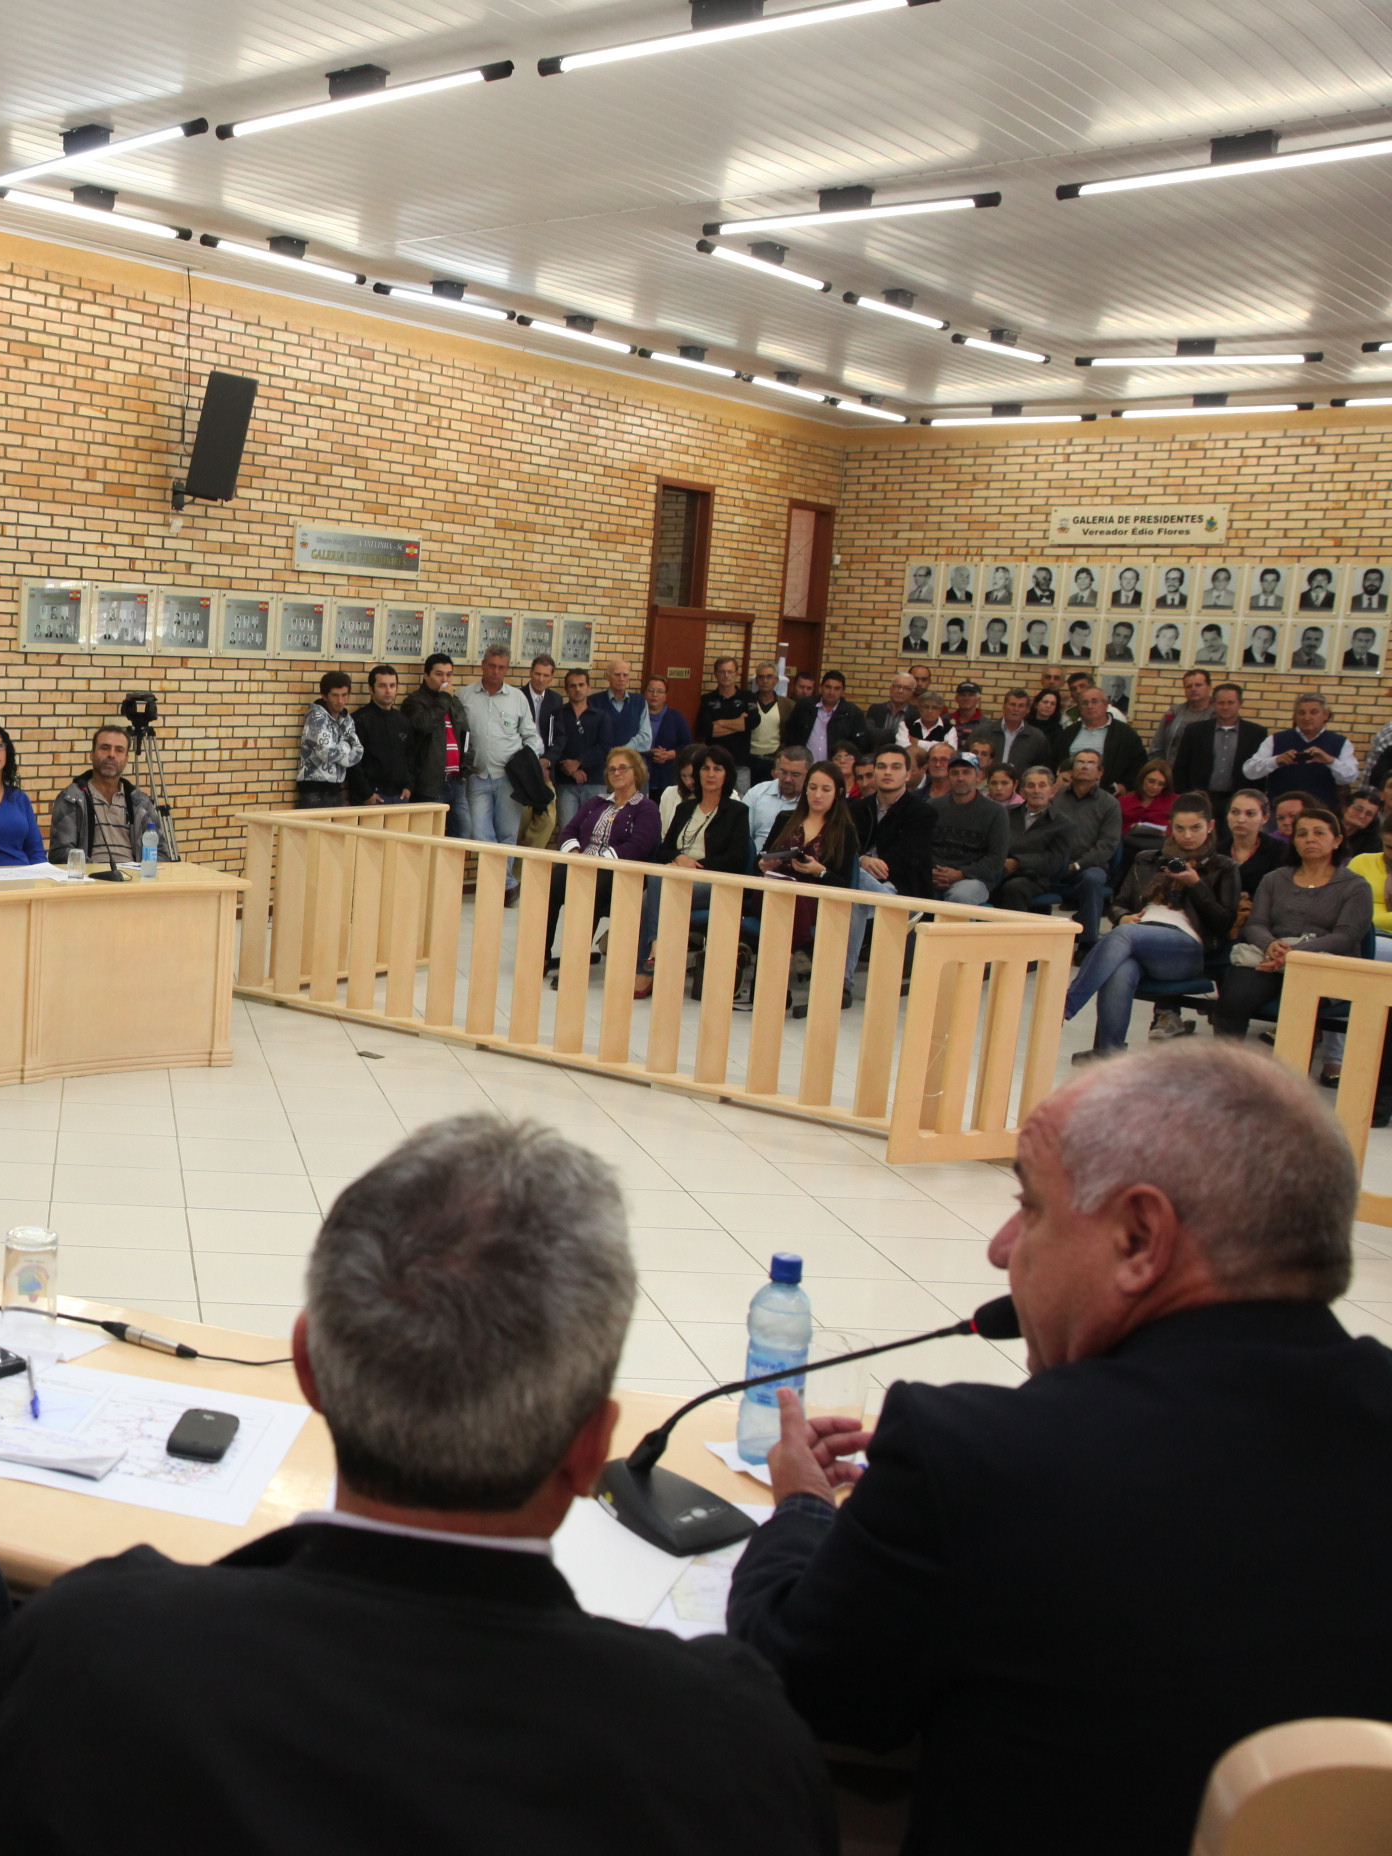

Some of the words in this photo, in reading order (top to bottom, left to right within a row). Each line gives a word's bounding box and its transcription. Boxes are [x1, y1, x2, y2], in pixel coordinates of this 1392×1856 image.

[1072, 515, 1115, 525] GALERIA
[1117, 515, 1131, 524] DE
[1133, 514, 1204, 524] PRESIDENTES
[1082, 528, 1128, 536] Vereador
[1131, 526, 1154, 536] Édio
[1157, 527, 1191, 536] Flores
[311, 548, 345, 561] GALERIA
